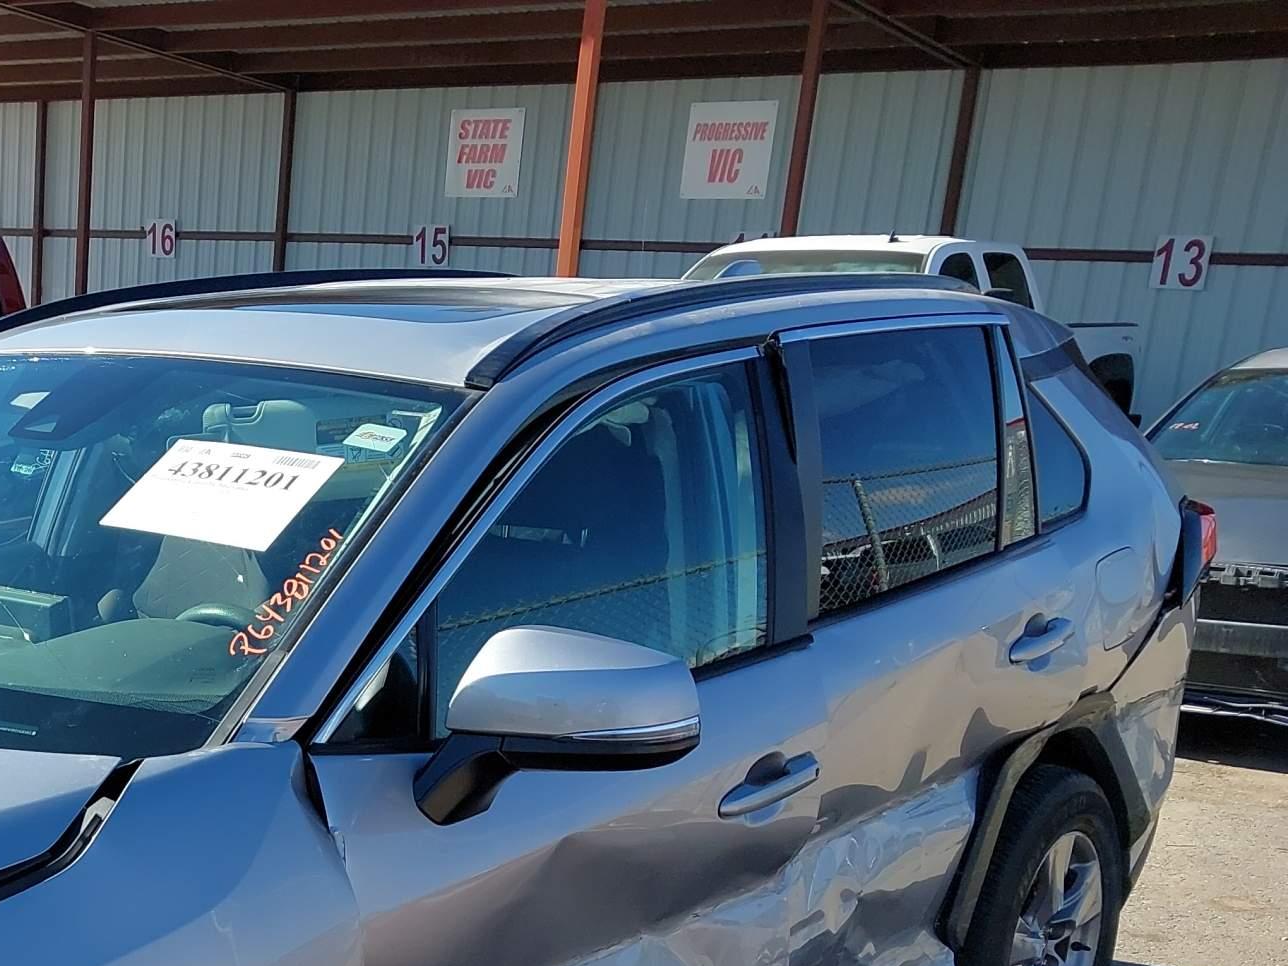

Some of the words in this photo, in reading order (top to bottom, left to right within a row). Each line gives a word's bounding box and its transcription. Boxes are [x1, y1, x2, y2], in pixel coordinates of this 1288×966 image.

[458, 119, 513, 140] STATE
[693, 121, 769, 141] PROGRESSIVE
[456, 143, 508, 164] FARM
[707, 148, 744, 183] VIC
[465, 168, 497, 189] VIC
[147, 222, 174, 256] 16
[415, 226, 447, 265] 15
[1155, 238, 1206, 287] 13
[168, 461, 300, 490] 43811201
